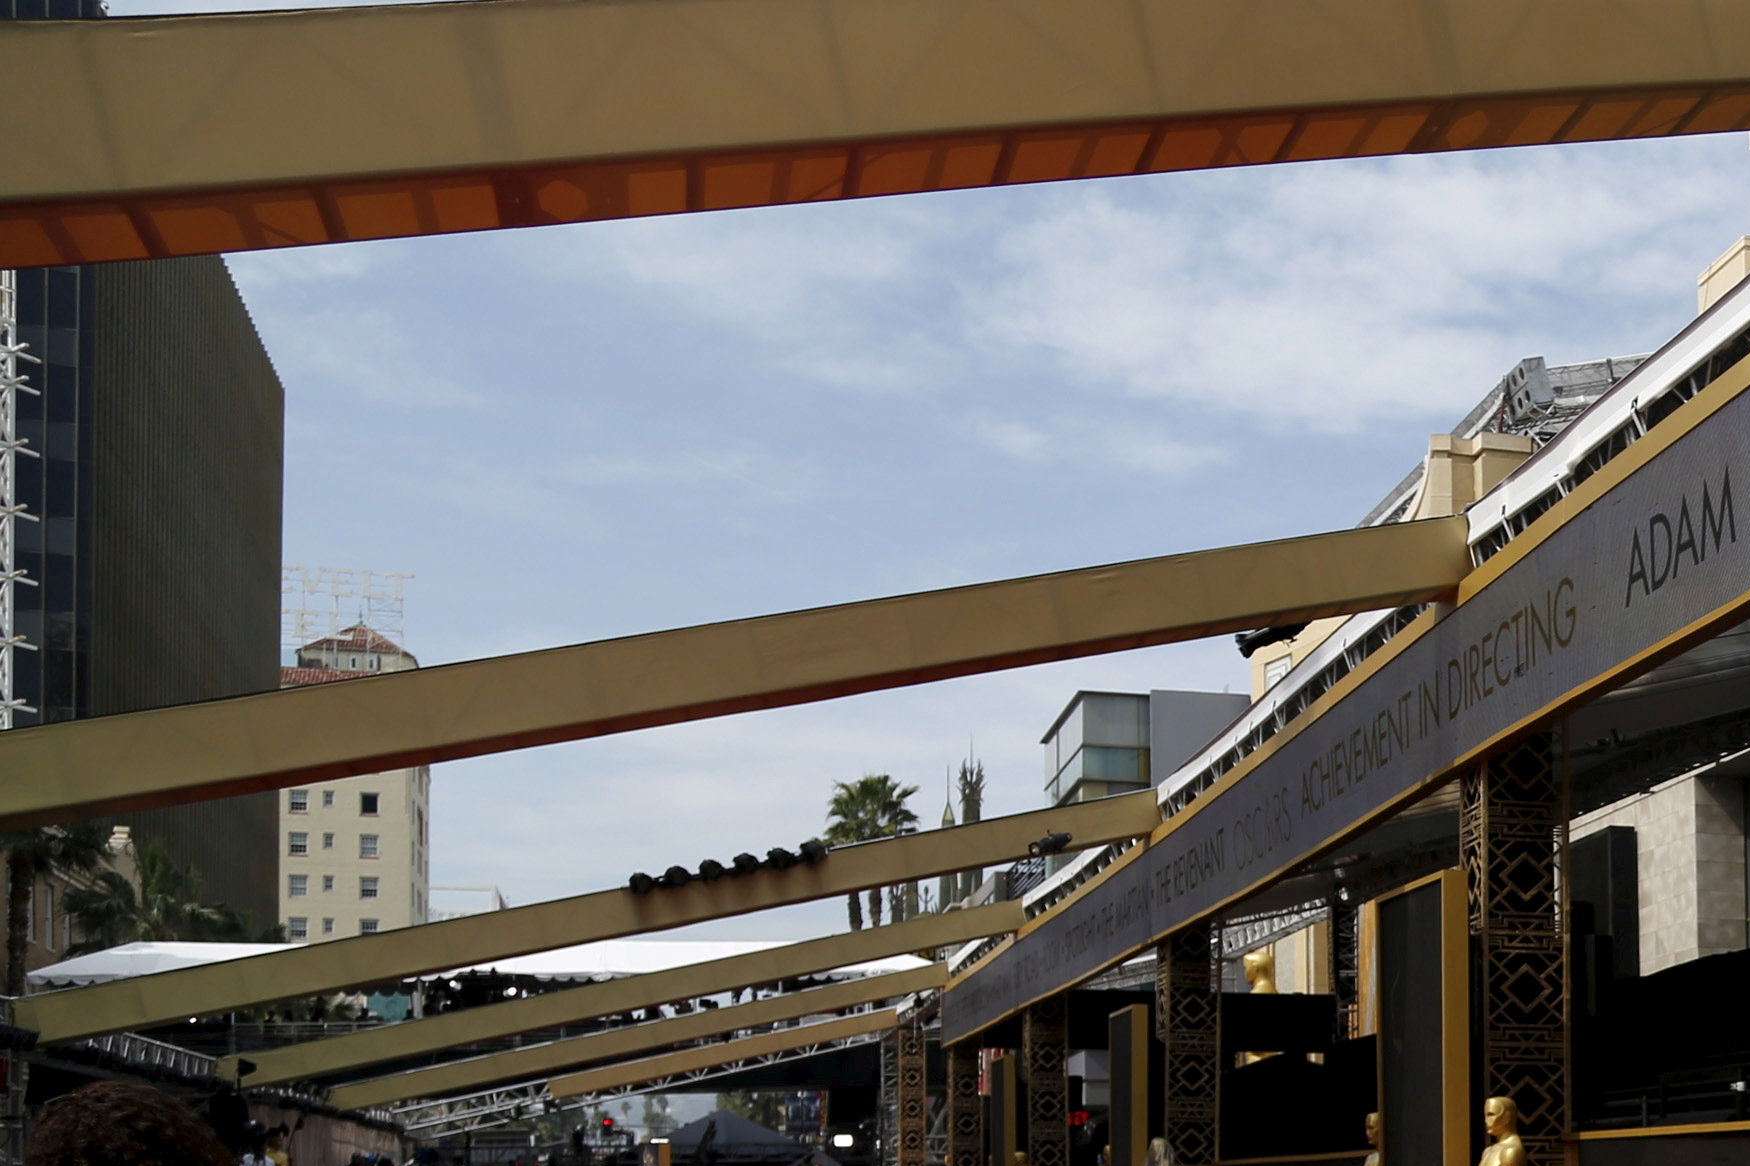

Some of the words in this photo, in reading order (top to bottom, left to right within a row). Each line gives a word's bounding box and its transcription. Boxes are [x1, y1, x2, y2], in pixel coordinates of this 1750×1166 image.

[1156, 864, 1172, 906] THE
[1174, 827, 1225, 897] REVENANT
[1233, 786, 1292, 871] OSCARS
[1300, 690, 1412, 820] ACHIEVEMENT
[1417, 670, 1441, 741] IN
[1448, 577, 1577, 721] DIRECTING
[1625, 466, 1736, 609] ADAM
